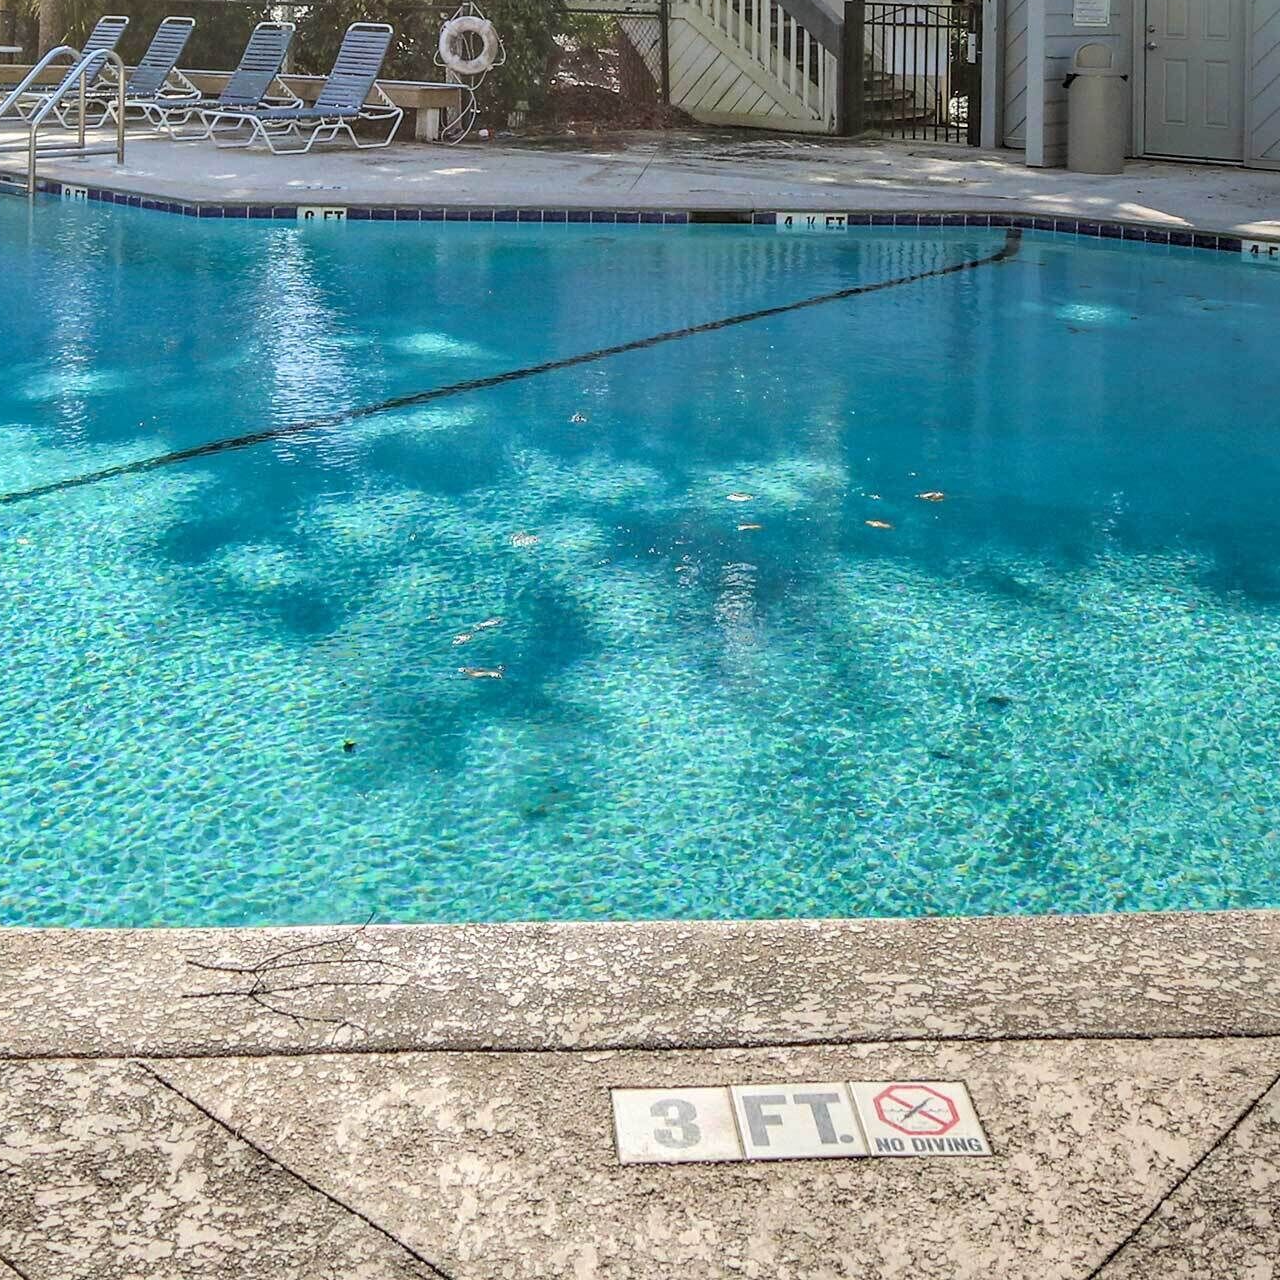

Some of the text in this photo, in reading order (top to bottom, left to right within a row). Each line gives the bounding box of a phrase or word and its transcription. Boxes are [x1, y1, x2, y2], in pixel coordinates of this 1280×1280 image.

[649, 1093, 854, 1149] 3 FT.
[875, 1137, 983, 1153] NO DIVING
